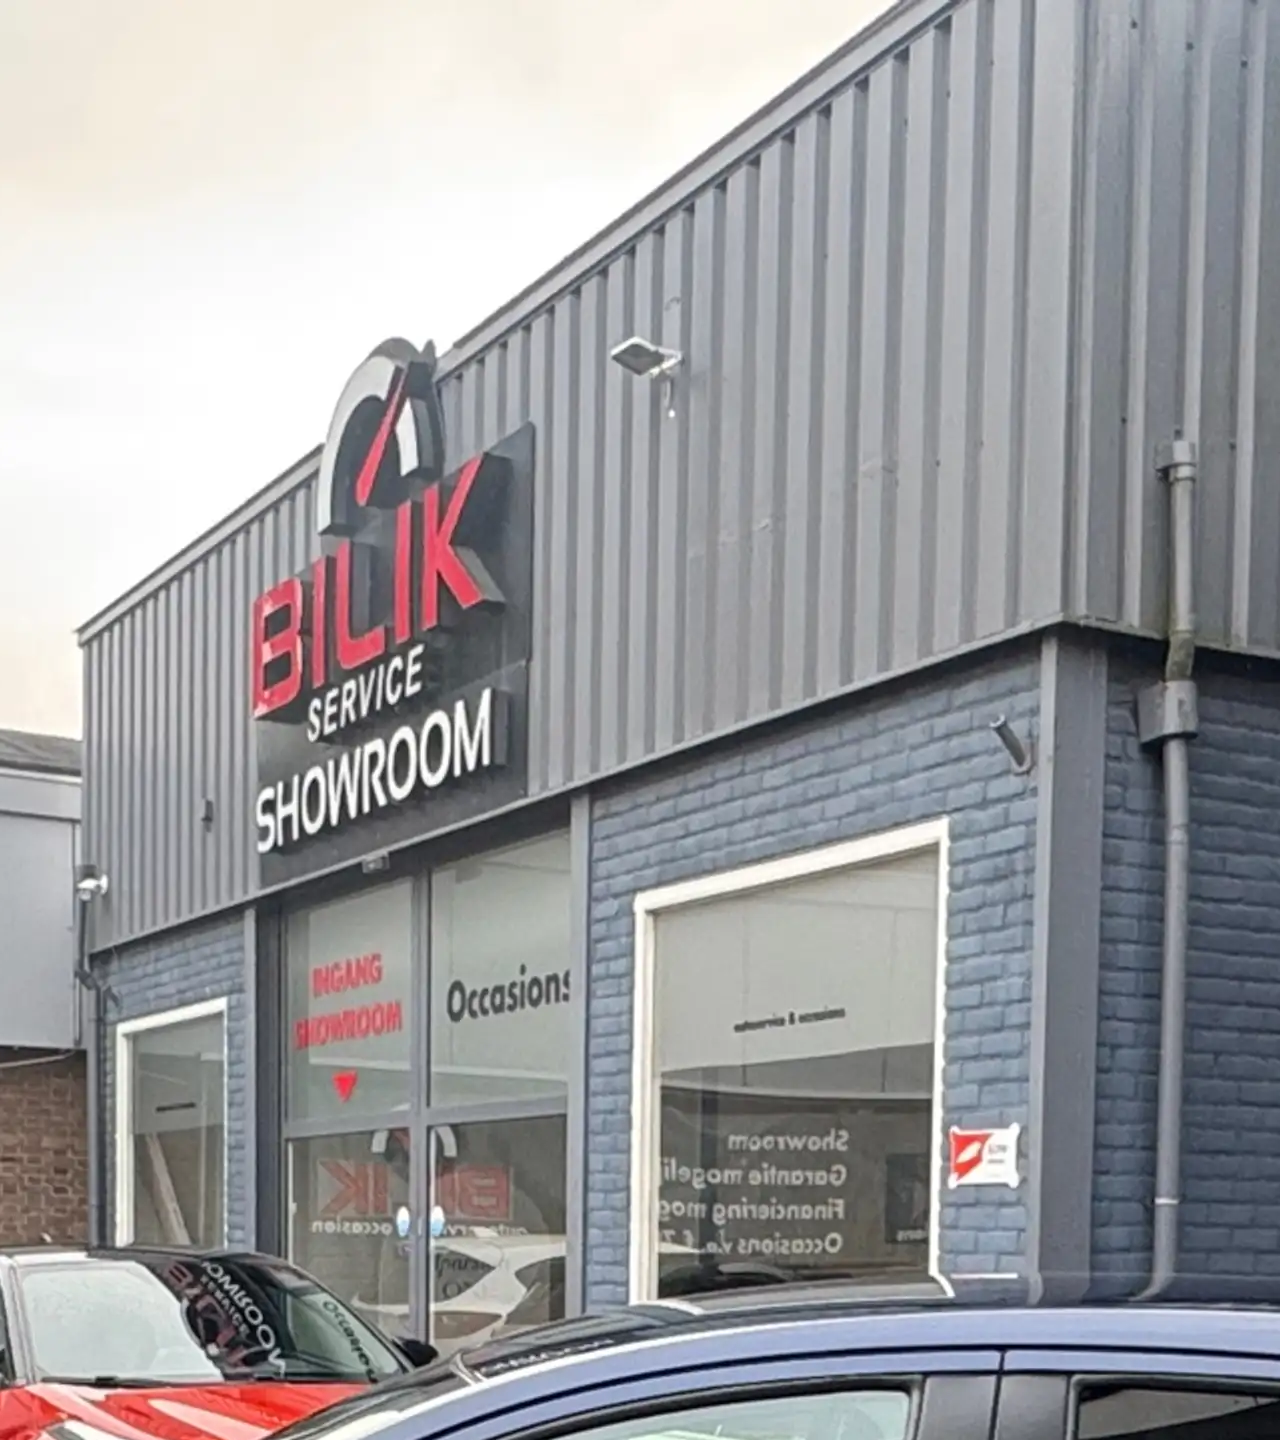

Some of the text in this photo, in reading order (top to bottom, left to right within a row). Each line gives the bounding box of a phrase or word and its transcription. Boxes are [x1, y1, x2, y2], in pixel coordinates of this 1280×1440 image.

[252, 451, 484, 719] BILIK
[255, 687, 492, 854] SHOWROOM
[307, 644, 425, 743] SERVICE
